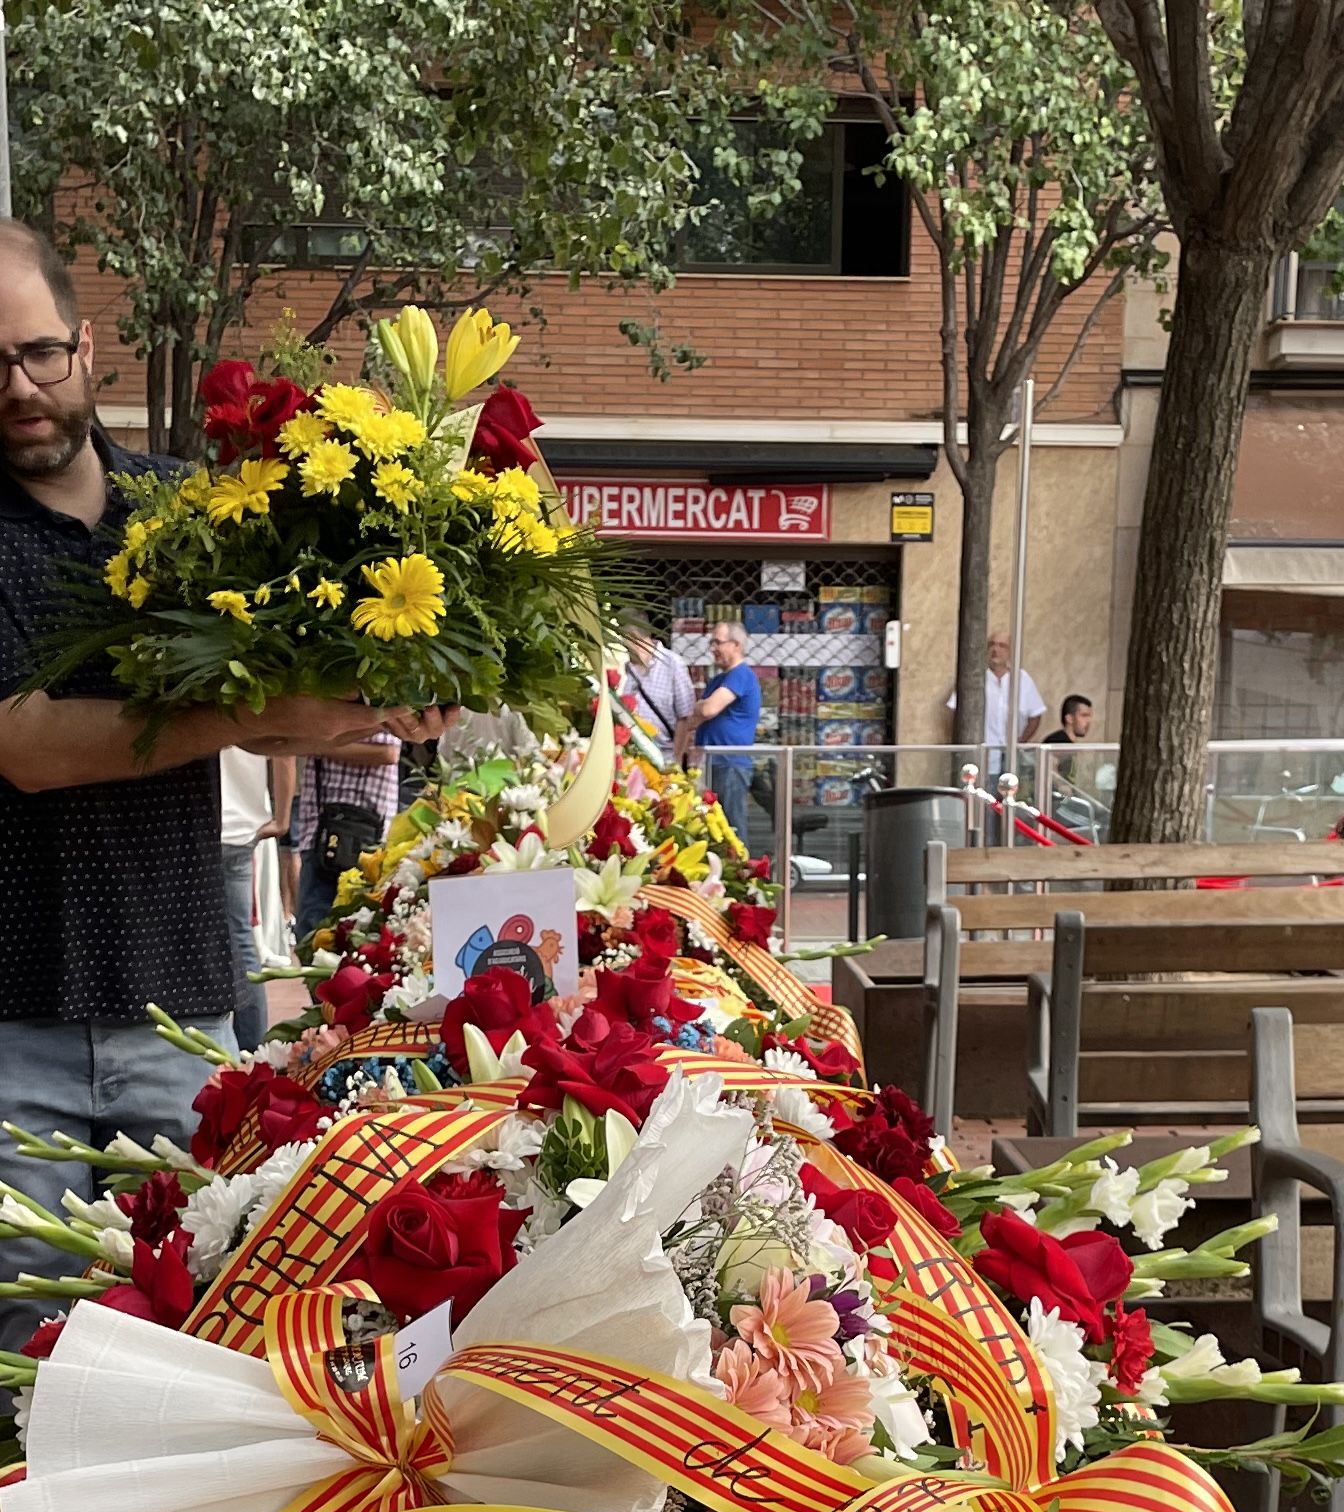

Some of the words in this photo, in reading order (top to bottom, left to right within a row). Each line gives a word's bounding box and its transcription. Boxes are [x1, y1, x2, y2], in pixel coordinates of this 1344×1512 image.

[560, 486, 766, 530] UPERMERCAT
[398, 1341, 418, 1370] 16
[683, 1427, 785, 1502] de
